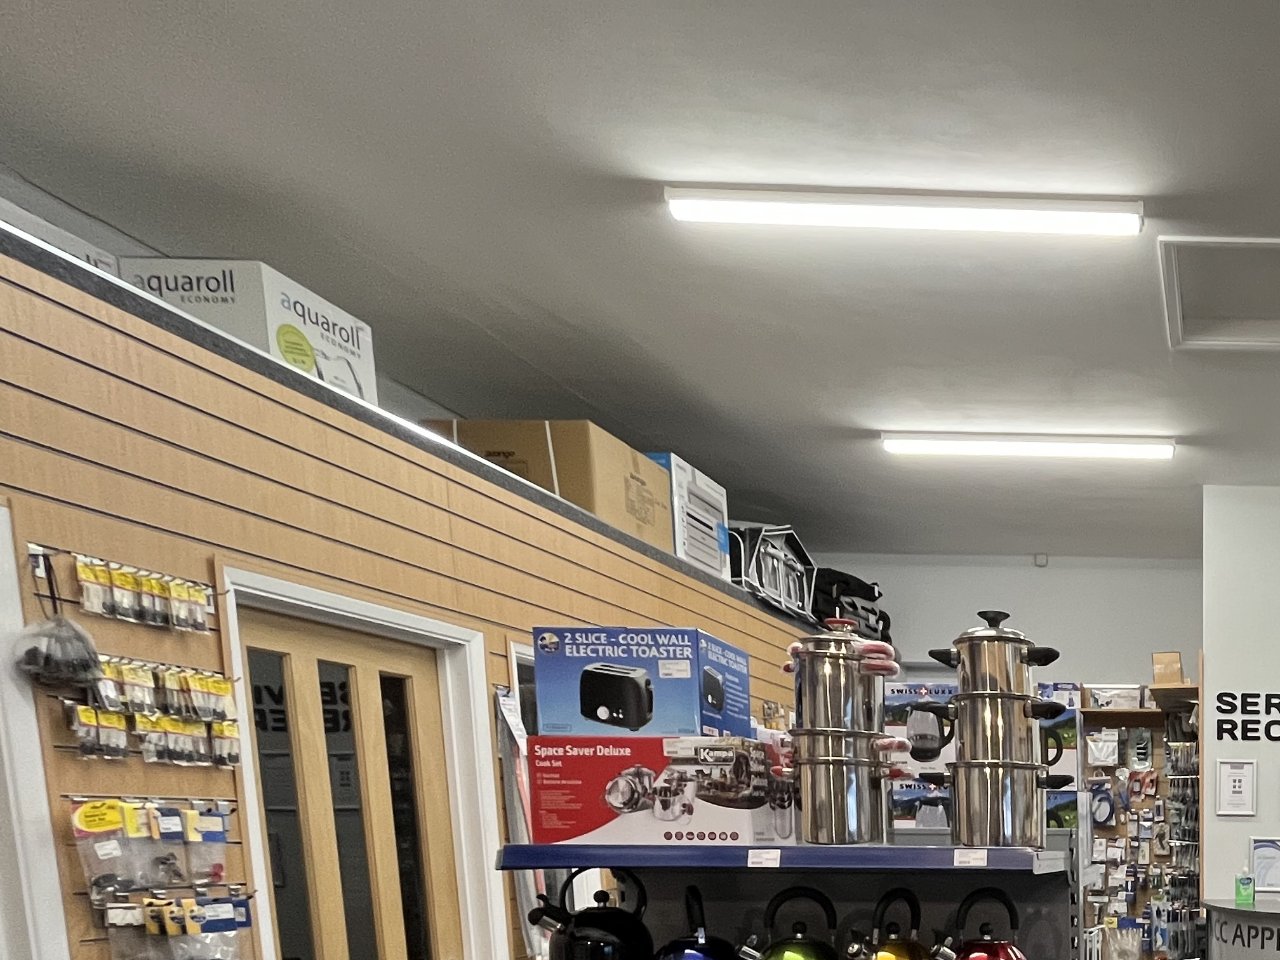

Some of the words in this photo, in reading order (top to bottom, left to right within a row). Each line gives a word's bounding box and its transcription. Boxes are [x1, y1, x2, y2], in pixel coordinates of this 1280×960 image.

[134, 269, 235, 297] aquaroll
[180, 294, 236, 304] ECONOMY
[280, 292, 361, 350] aquaroll
[564, 633, 573, 643] 2
[576, 632, 607, 644] SLICE
[618, 633, 654, 645] COOL
[656, 634, 691, 645] WALL
[565, 645, 629, 657] ELECTRIC
[632, 646, 693, 658] TOASTER
[891, 687, 918, 695] SWISS
[534, 745, 564, 759] Space
[565, 745, 595, 756] Saver
[596, 745, 631, 756] Deluxe
[700, 748, 733, 763] Kampa
[535, 759, 551, 767] Cook
[551, 759, 562, 767] Set
[1212, 919, 1228, 943] CC
